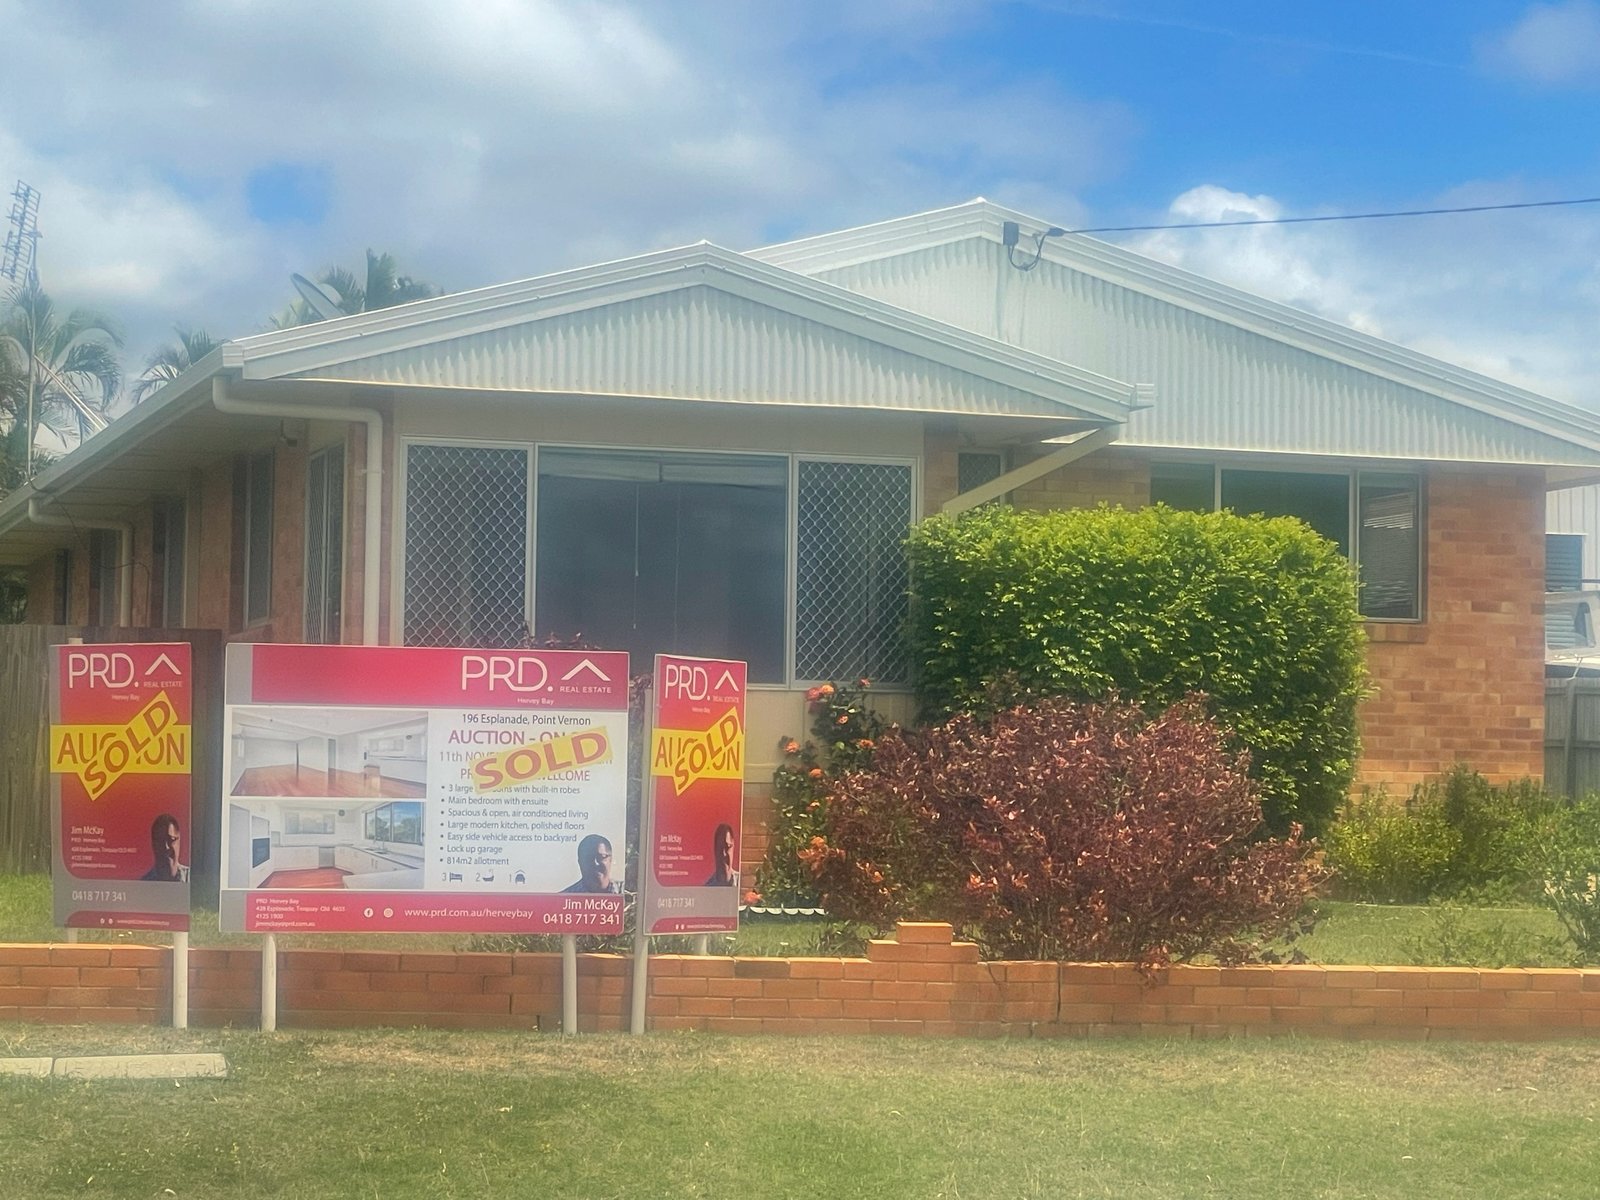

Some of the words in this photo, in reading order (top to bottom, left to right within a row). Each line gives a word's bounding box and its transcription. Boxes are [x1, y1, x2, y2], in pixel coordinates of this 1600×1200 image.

[582, 686, 612, 694] ESTATE
[463, 714, 479, 723] 196
[481, 714, 530, 725] Esplanade,
[532, 715, 556, 725] Point
[558, 715, 591, 725] Vernon
[448, 730, 525, 745] AUCTION
[84, 700, 170, 795] SOLD
[675, 715, 738, 790] SOLD
[440, 751, 463, 762] 11th
[475, 732, 607, 789] SOLD
[448, 784, 453, 792] 3
[455, 784, 473, 794] large
[514, 785, 530, 793] with
[532, 785, 558, 793] built-in
[560, 786, 580, 794] robes
[448, 796, 467, 804] Main
[469, 796, 502, 805] bedroom
[504, 797, 521, 805] with
[522, 798, 549, 806] ensuite
[448, 808, 480, 818] Spacious
[523, 810, 567, 818] conditioned
[569, 810, 589, 820] living
[71, 826, 82, 834] Jim
[83, 826, 104, 836] McKay
[448, 821, 468, 830] Large
[470, 821, 499, 829] modern
[531, 821, 563, 831] polished
[564, 821, 585, 830] floors
[447, 832, 464, 842] Easy
[466, 832, 480, 841] side
[482, 833, 507, 841] vehicle
[509, 834, 533, 842] access
[544, 834, 577, 844] backyard
[447, 844, 464, 853] Lock
[466, 846, 476, 854] up
[477, 846, 503, 854] garage
[447, 857, 472, 865] 814m2
[474, 857, 509, 865] allotment
[72, 891, 92, 901] 0418
[95, 891, 110, 901] 717
[112, 892, 126, 901] 341
[562, 899, 581, 910] Jim
[584, 899, 620, 913] McKay
[404, 908, 533, 919] www.prd.com.au/herveybay
[543, 913, 572, 924] 0418
[575, 914, 597, 924] 717
[600, 914, 620, 925] 341
